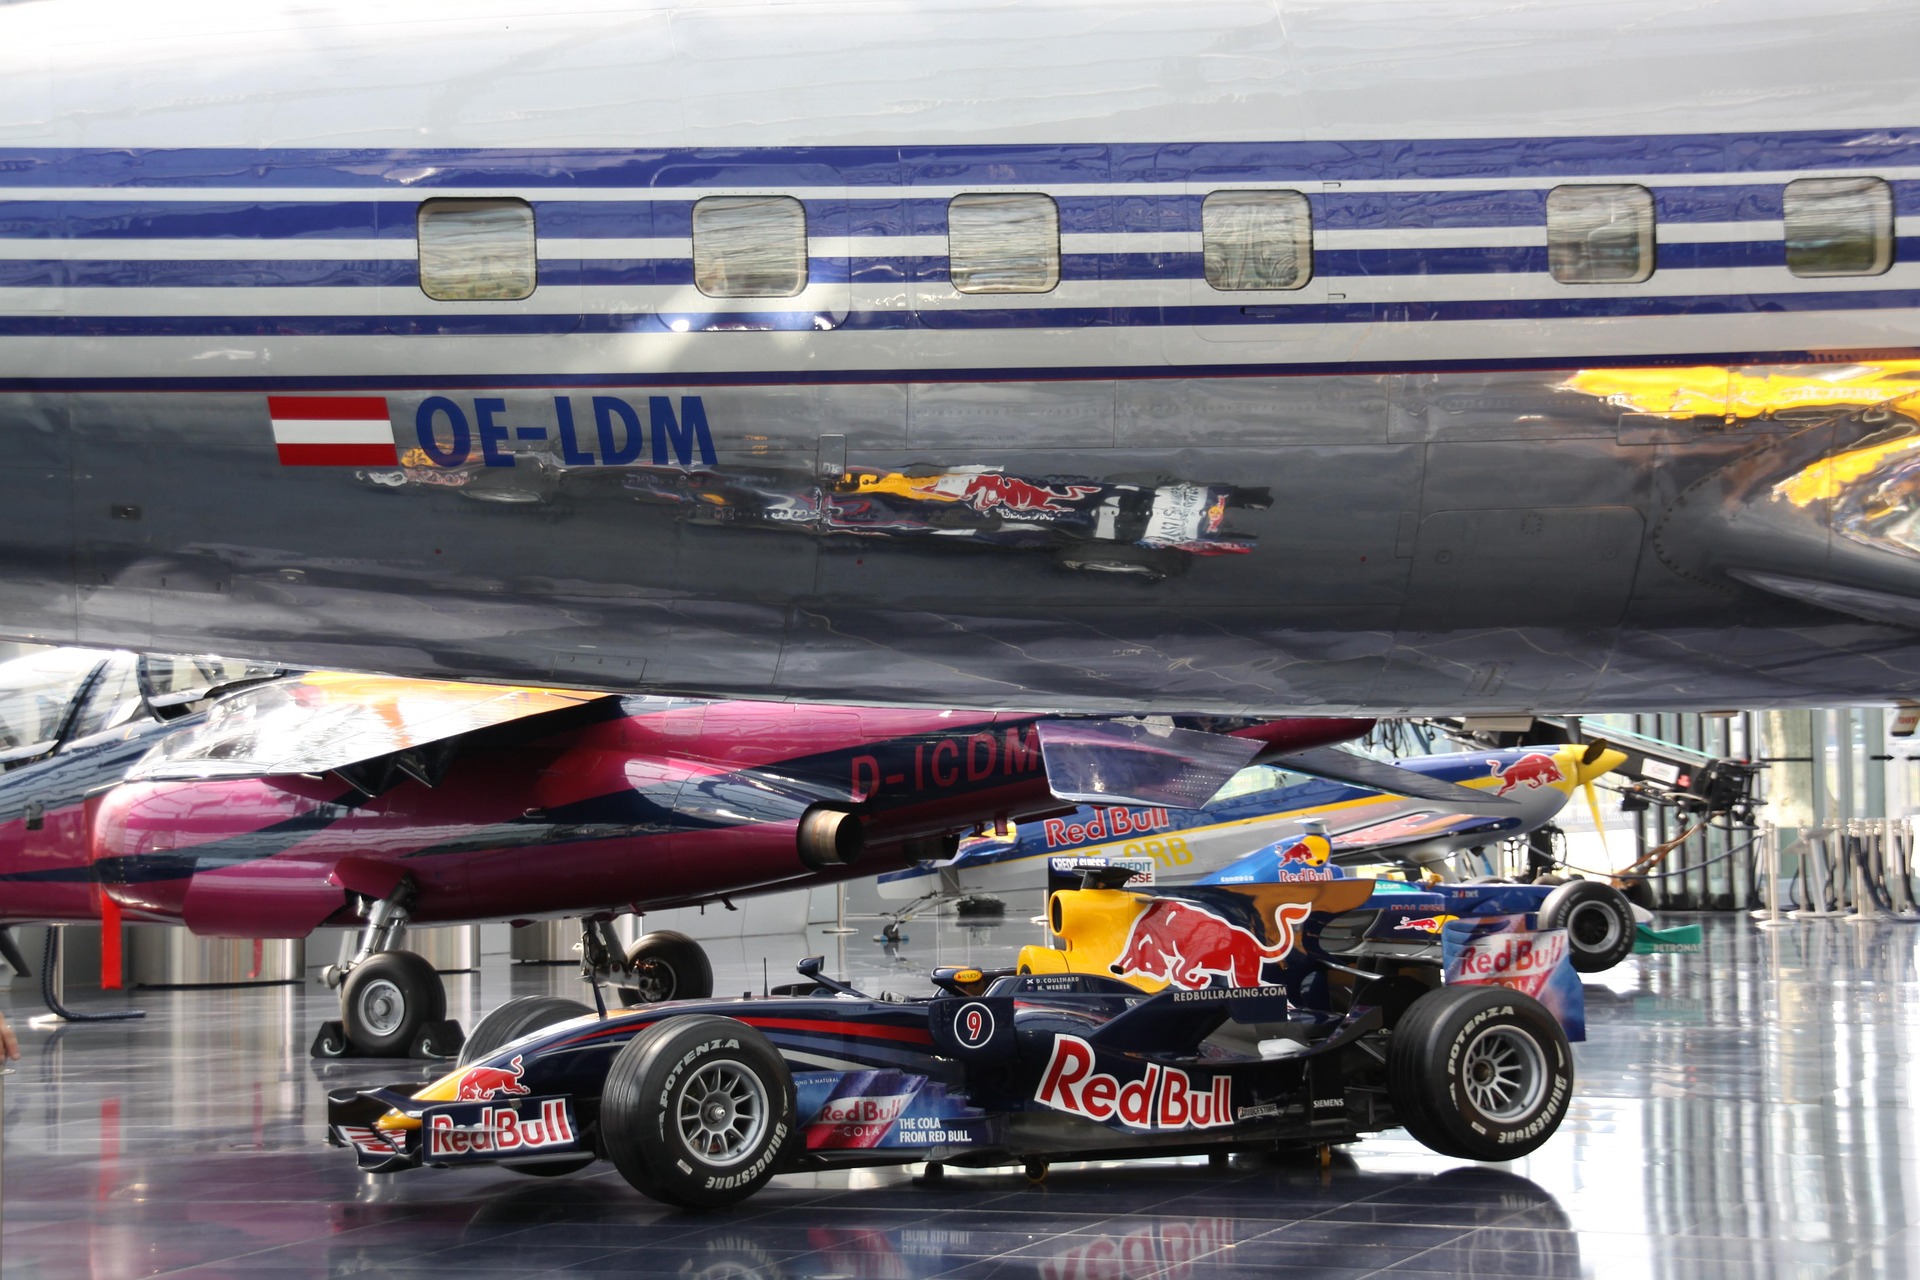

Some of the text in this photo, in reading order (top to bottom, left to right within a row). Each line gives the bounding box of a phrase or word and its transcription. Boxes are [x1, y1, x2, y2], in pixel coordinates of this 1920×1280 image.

[415, 395, 718, 468] OE-LDM
[851, 723, 1040, 799] D-ICDM
[1044, 806, 1170, 847] Red Bull
[1279, 867, 1334, 882] Red Bull
[1460, 935, 1564, 976] Red Bull
[1173, 986, 1287, 1002] REDBULLRACING.COM
[966, 1010, 983, 1041] 9
[1447, 1005, 1515, 1075] POTENZA
[659, 1038, 740, 1108] POTENZA
[1037, 1035, 1233, 1128] Red Bull
[819, 1099, 901, 1122] Red Bull
[899, 1117, 941, 1130] THE COLA
[1313, 1098, 1344, 1108] SIEMENS
[1497, 1073, 1568, 1144] BRIDGESTONE
[432, 1108, 493, 1154] Red
[496, 1099, 573, 1149] Bull
[843, 1126, 880, 1137] COLA
[899, 1130, 972, 1143] FROM RED BULL.
[704, 1121, 788, 1190] BRIDGESTONE
